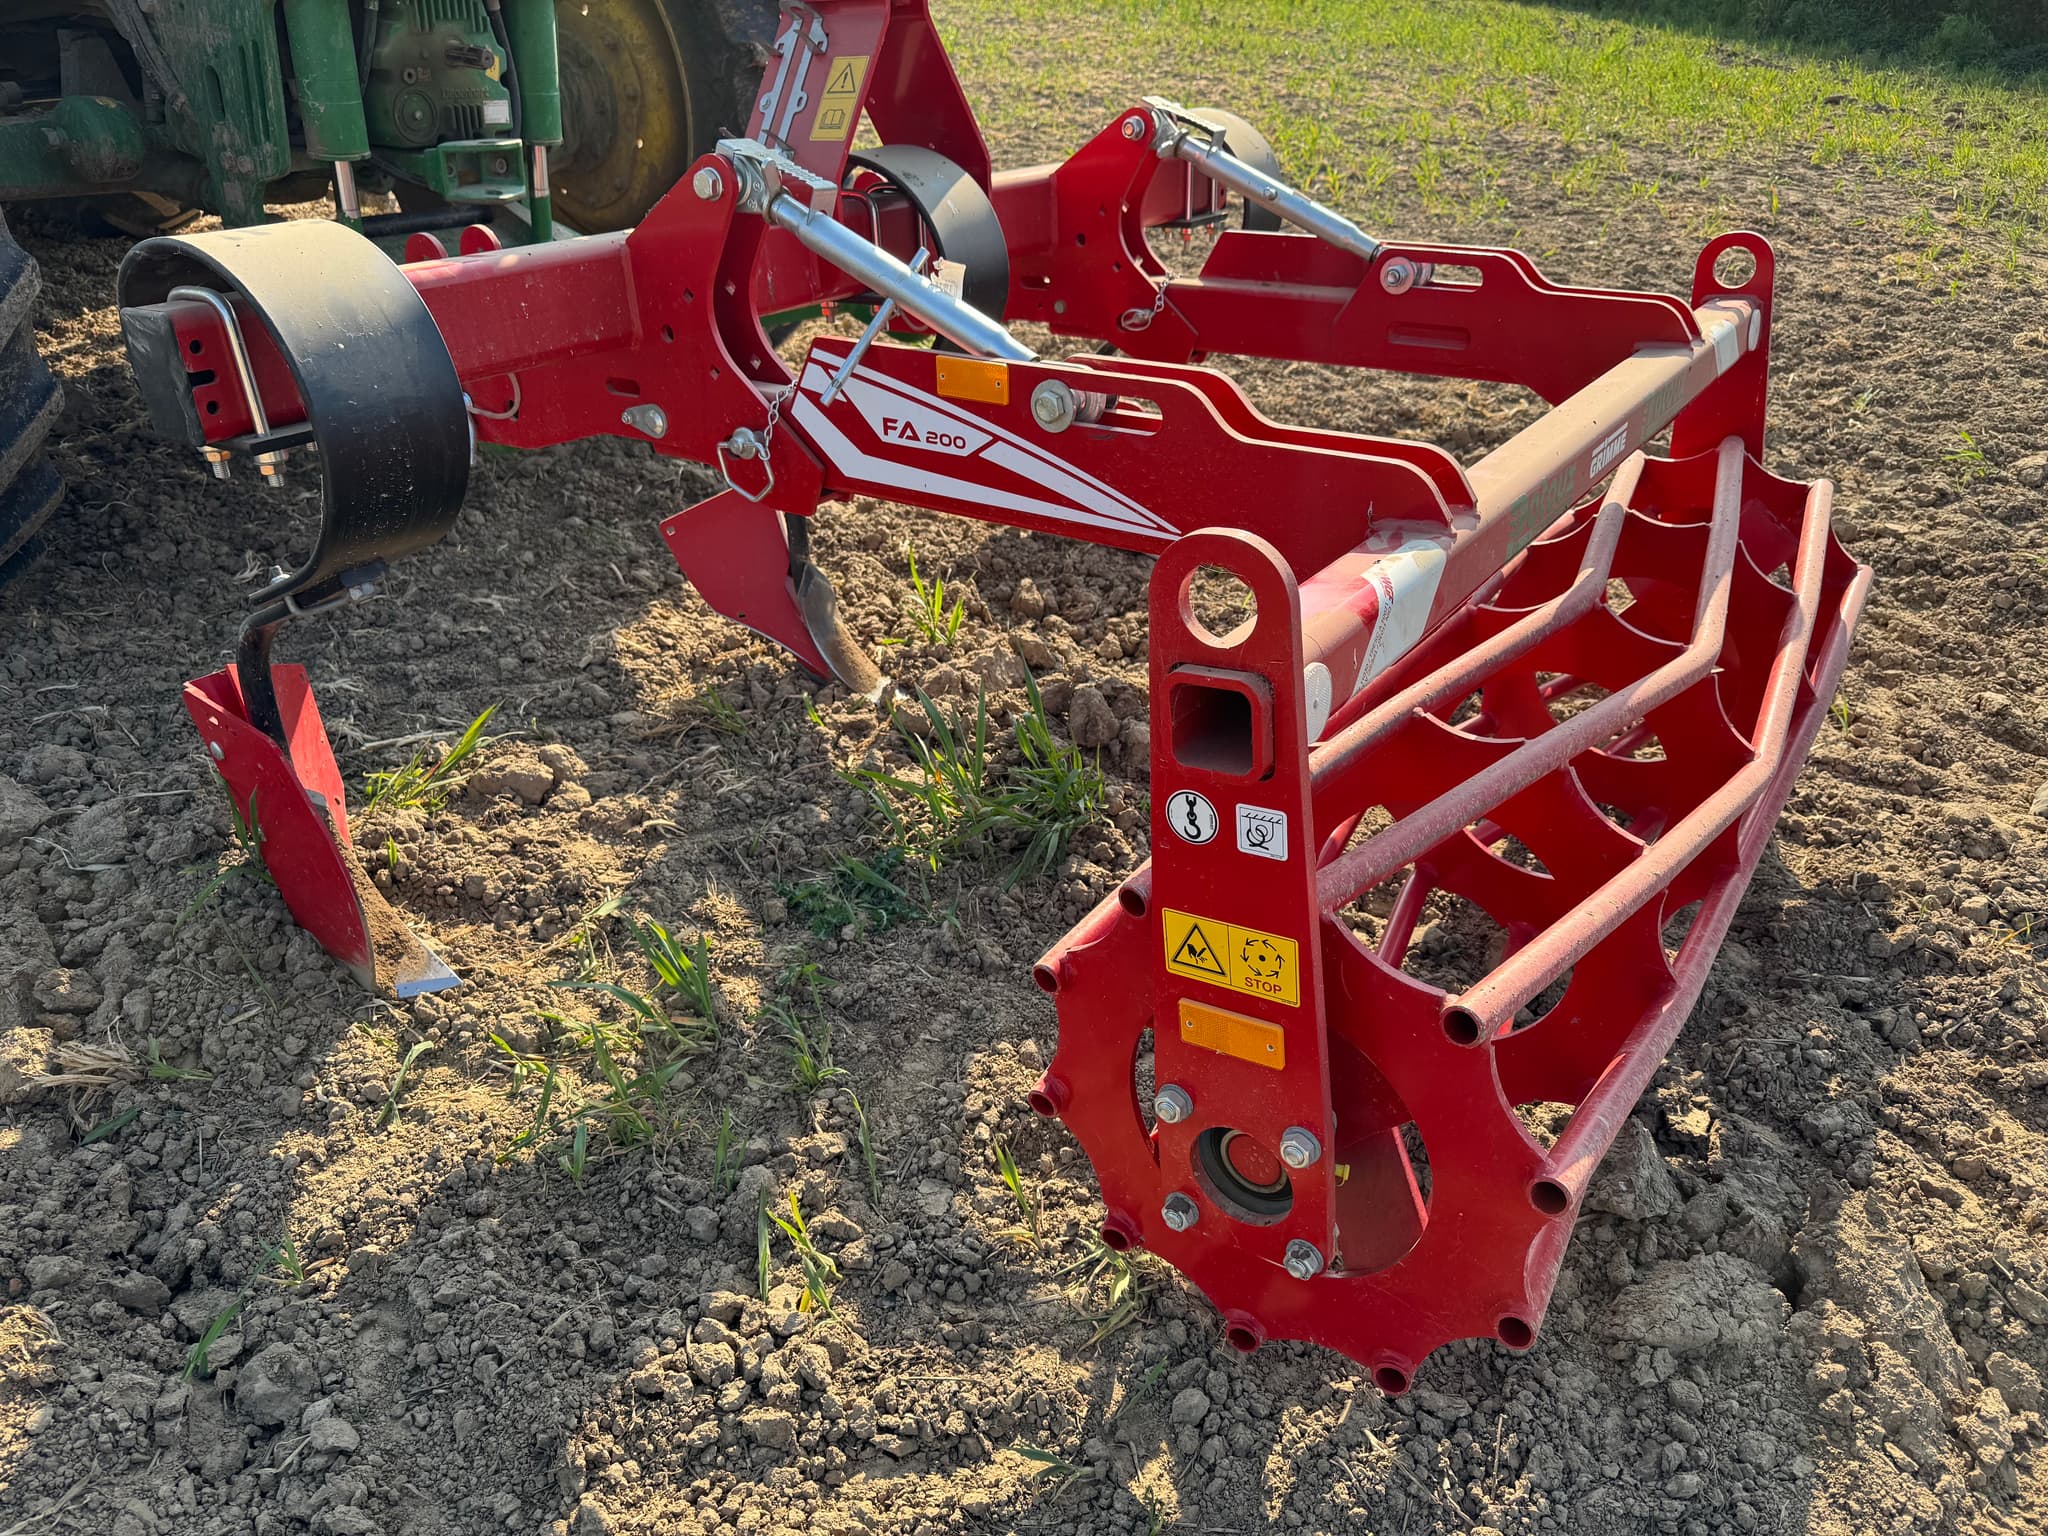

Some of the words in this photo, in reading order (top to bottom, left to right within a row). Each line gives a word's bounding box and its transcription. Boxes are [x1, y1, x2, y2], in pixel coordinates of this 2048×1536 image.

[882, 417, 921, 442] FA
[926, 431, 966, 449] 200
[1590, 431, 1628, 479] GRIMME
[1245, 976, 1282, 995] STOP
